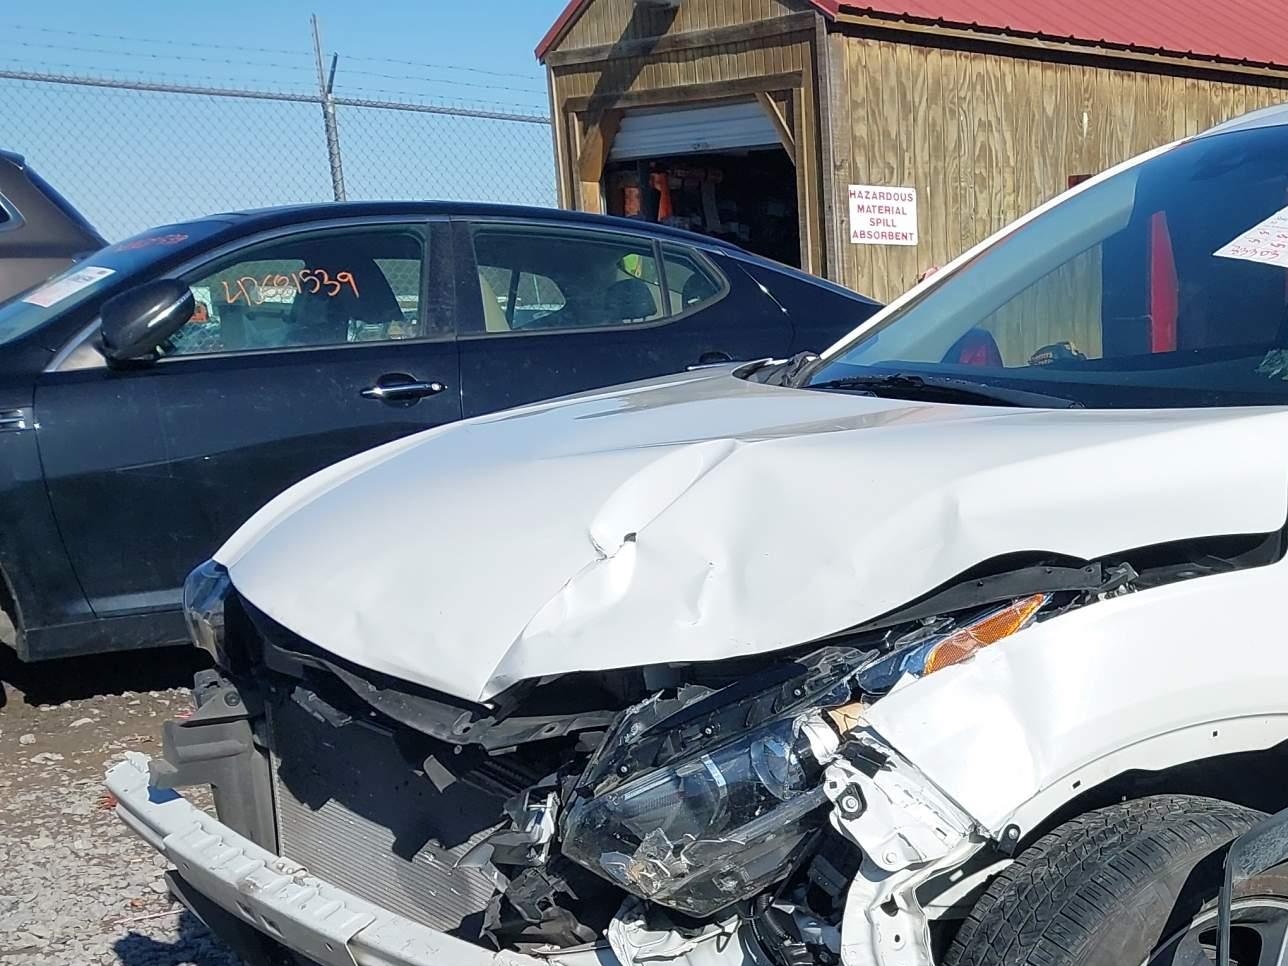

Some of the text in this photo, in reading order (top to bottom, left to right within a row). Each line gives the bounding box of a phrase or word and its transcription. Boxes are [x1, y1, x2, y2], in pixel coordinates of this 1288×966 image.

[849, 189, 914, 202] HAZARDOUS
[857, 204, 908, 215] MATERIAL
[869, 217, 897, 228] SPILL
[852, 230, 914, 241] ABSORBENT
